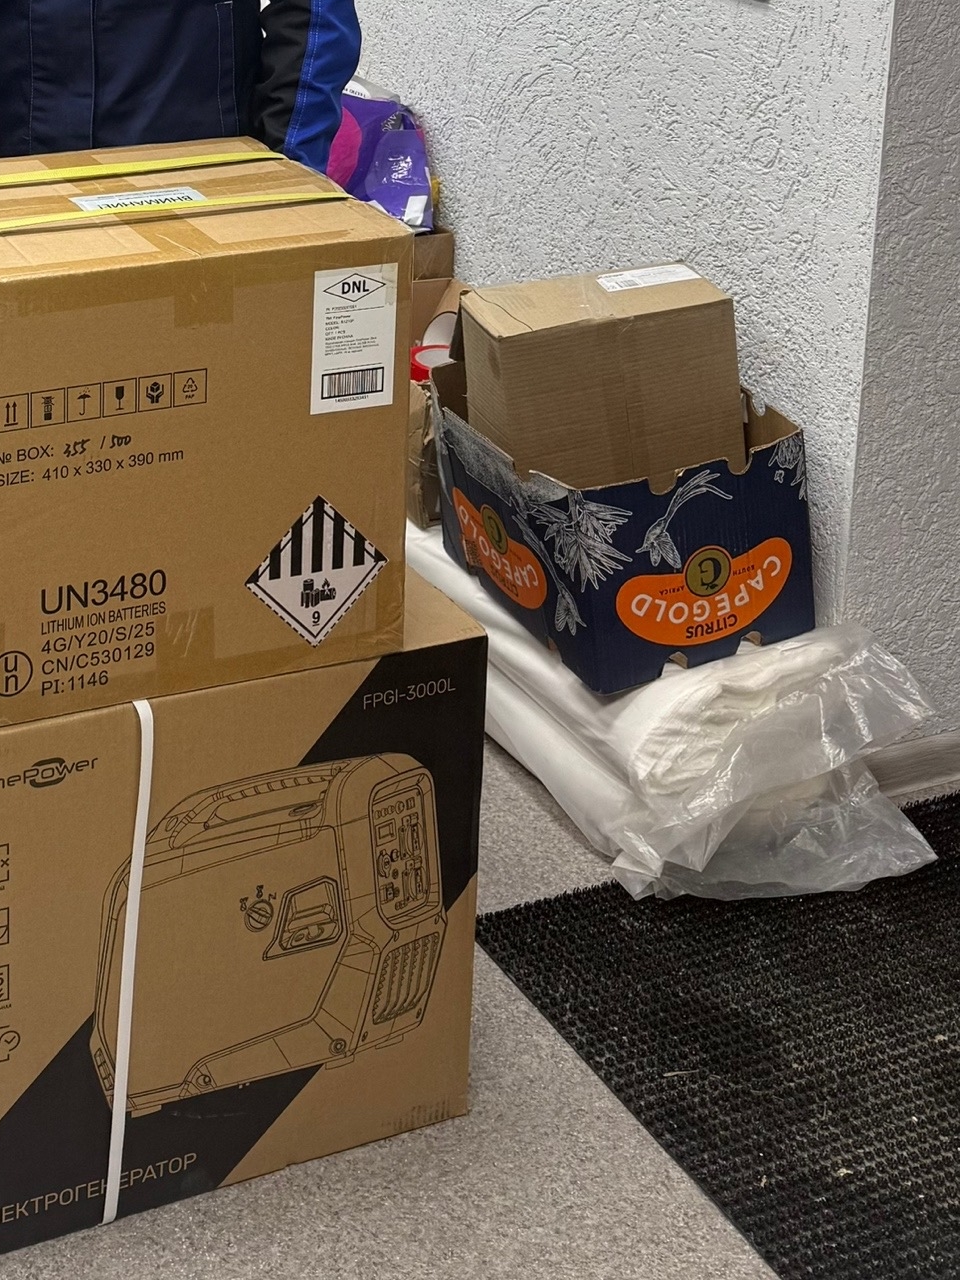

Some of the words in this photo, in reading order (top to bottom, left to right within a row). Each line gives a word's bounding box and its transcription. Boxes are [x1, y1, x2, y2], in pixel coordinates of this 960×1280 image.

[341, 279, 369, 295] DNL
[17, 444, 54, 462] BOX:
[42, 465, 68, 481] 410
[73, 465, 82, 476] x
[86, 458, 111, 475] 330
[116, 458, 124, 469] x
[128, 452, 153, 468] 390
[158, 450, 184, 463] mm
[41, 569, 167, 615] UN3480
[631, 556, 781, 624] CAPEGOLD
[41, 615, 84, 635] LITHIUM
[87, 611, 106, 627] ION
[108, 601, 166, 623] BATTERIES
[312, 611, 320, 624] 9
[685, 613, 738, 639] CITRUS
[41, 621, 155, 654] 4G/Y20/S/25
[42, 642, 155, 675] CN/C530129
[42, 670, 109, 696] PI:1146
[363, 677, 456, 710] FPGI-3000L
